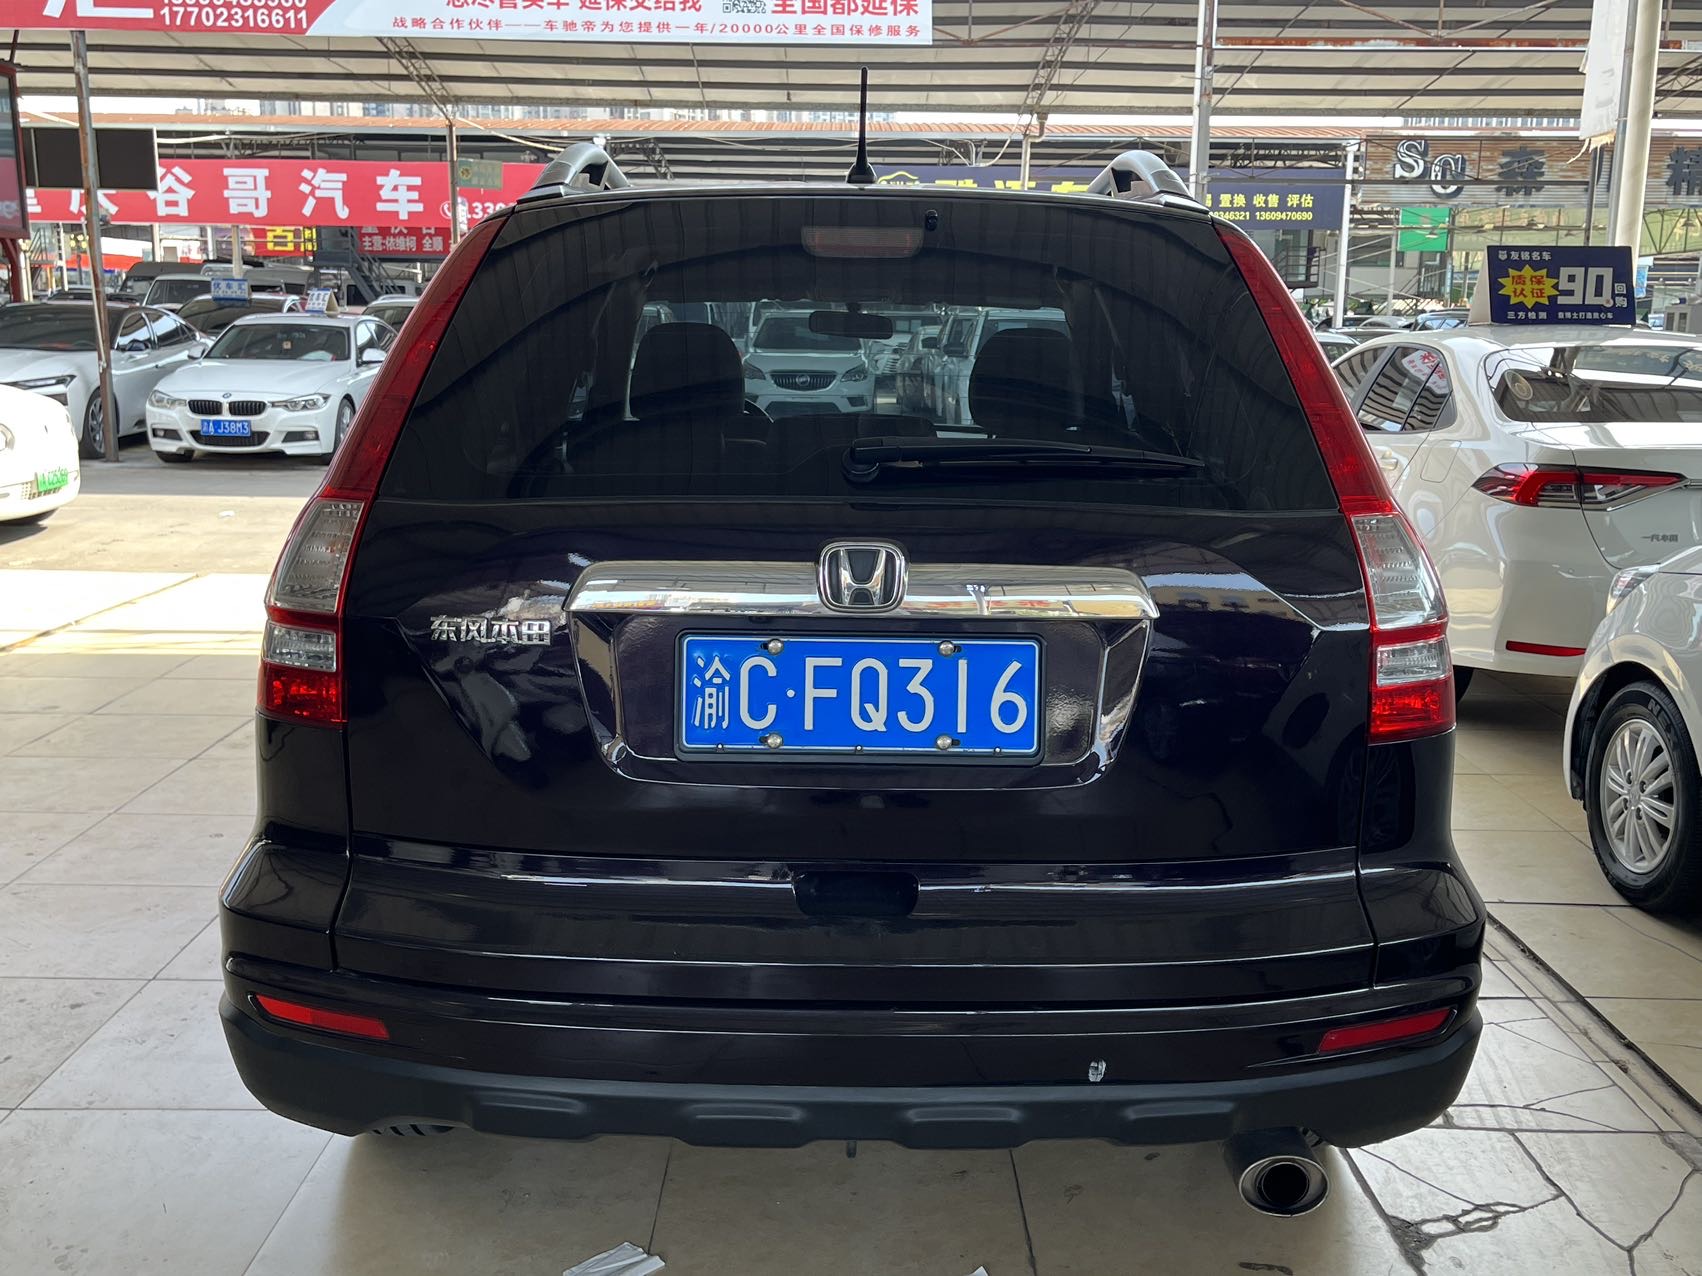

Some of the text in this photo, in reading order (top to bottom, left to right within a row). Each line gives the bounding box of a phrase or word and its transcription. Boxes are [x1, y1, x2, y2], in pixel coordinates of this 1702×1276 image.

[160, 6, 307, 29] 17702316611
[1219, 193, 1246, 208] 置换
[1253, 193, 1279, 208] 收售
[1287, 193, 1314, 208] 评估
[1557, 266, 1613, 304] 90
[430, 615, 551, 645] 东风本田
